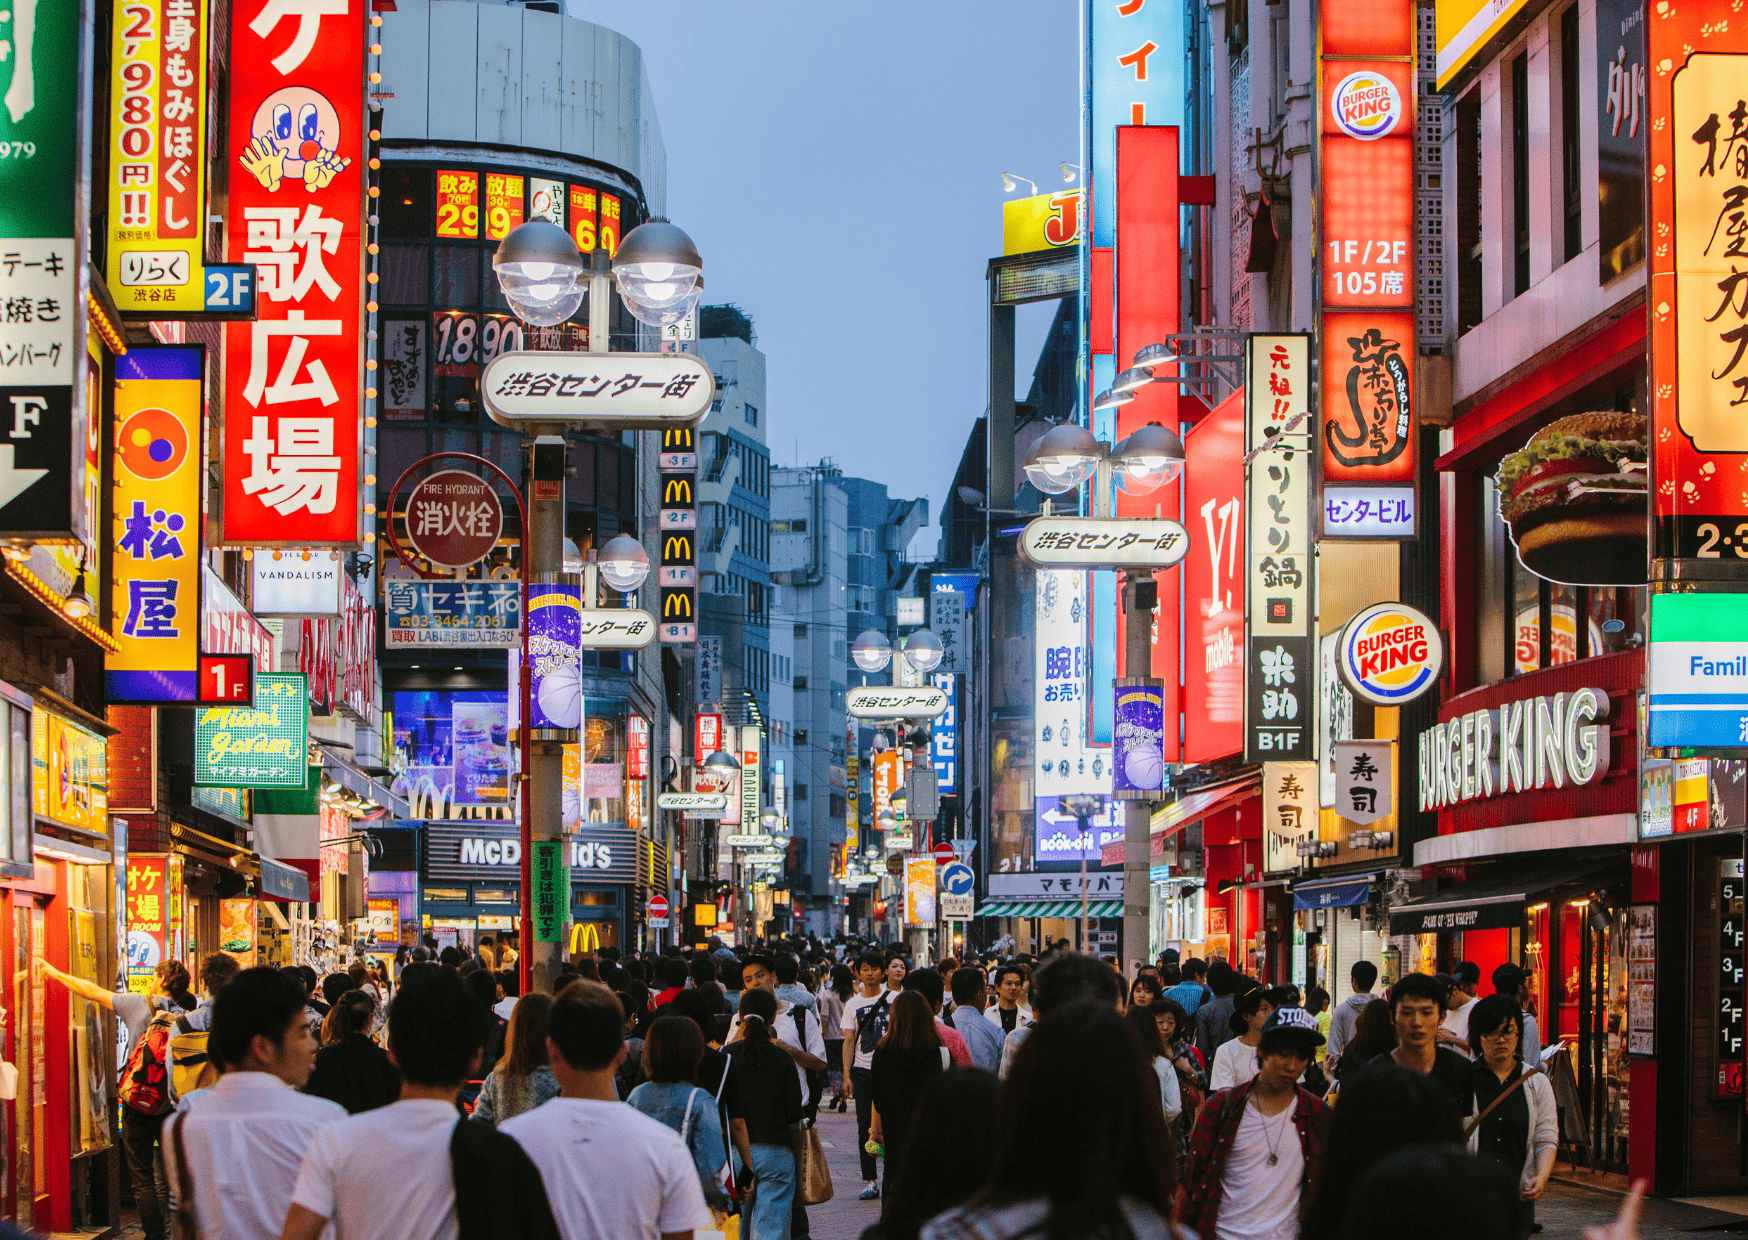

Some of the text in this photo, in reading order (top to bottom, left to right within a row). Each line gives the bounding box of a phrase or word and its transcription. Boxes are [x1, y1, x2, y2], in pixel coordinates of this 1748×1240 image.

[249, 0, 348, 75] ケ
[1342, 86, 1389, 109] BURGER
[1345, 97, 1391, 123] KING
[1044, 193, 1087, 246] J
[129, 256, 182, 283] りらく
[1332, 271, 1404, 295] 105席
[133, 288, 176, 302] 渋谷店
[206, 272, 250, 307] 2F
[0, 297, 61, 324] 焼き
[243, 203, 346, 517] 歌広場
[496, 373, 701, 399] 渋谷センター街
[1269, 345, 1292, 421] 元祖!!
[9, 396, 49, 439] F
[423, 483, 486, 495] FIRE HYDRANT
[416, 501, 493, 537] 消火栓
[1326, 499, 1412, 524] センタービル
[1034, 531, 1181, 551] 渋谷センター街
[117, 500, 186, 639] 松屋
[259, 571, 334, 580] VANDALISM
[391, 583, 518, 614] 質 セキネ
[411, 613, 507, 627] 03-3464-2061
[581, 621, 648, 636] ンター街
[669, 626, 689, 637] B1
[391, 630, 416, 643] 買取
[1357, 625, 1425, 658] BURGER
[1205, 627, 1234, 674] mobile
[1360, 640, 1428, 681] KING
[211, 664, 244, 698] 1F
[1260, 645, 1299, 721] 米助
[852, 695, 942, 708] 渋谷センター街
[201, 704, 281, 729] Miami
[1258, 733, 1300, 750] B1F
[1419, 688, 1603, 812] BURGER KING
[1349, 753, 1379, 813] 寿司
[661, 797, 721, 805] 渋谷センター街
[1278, 773, 1304, 829] 寿司
[1686, 807, 1698, 828] 4F
[460, 838, 612, 869] McDld's
[131, 922, 162, 932] ROOM
